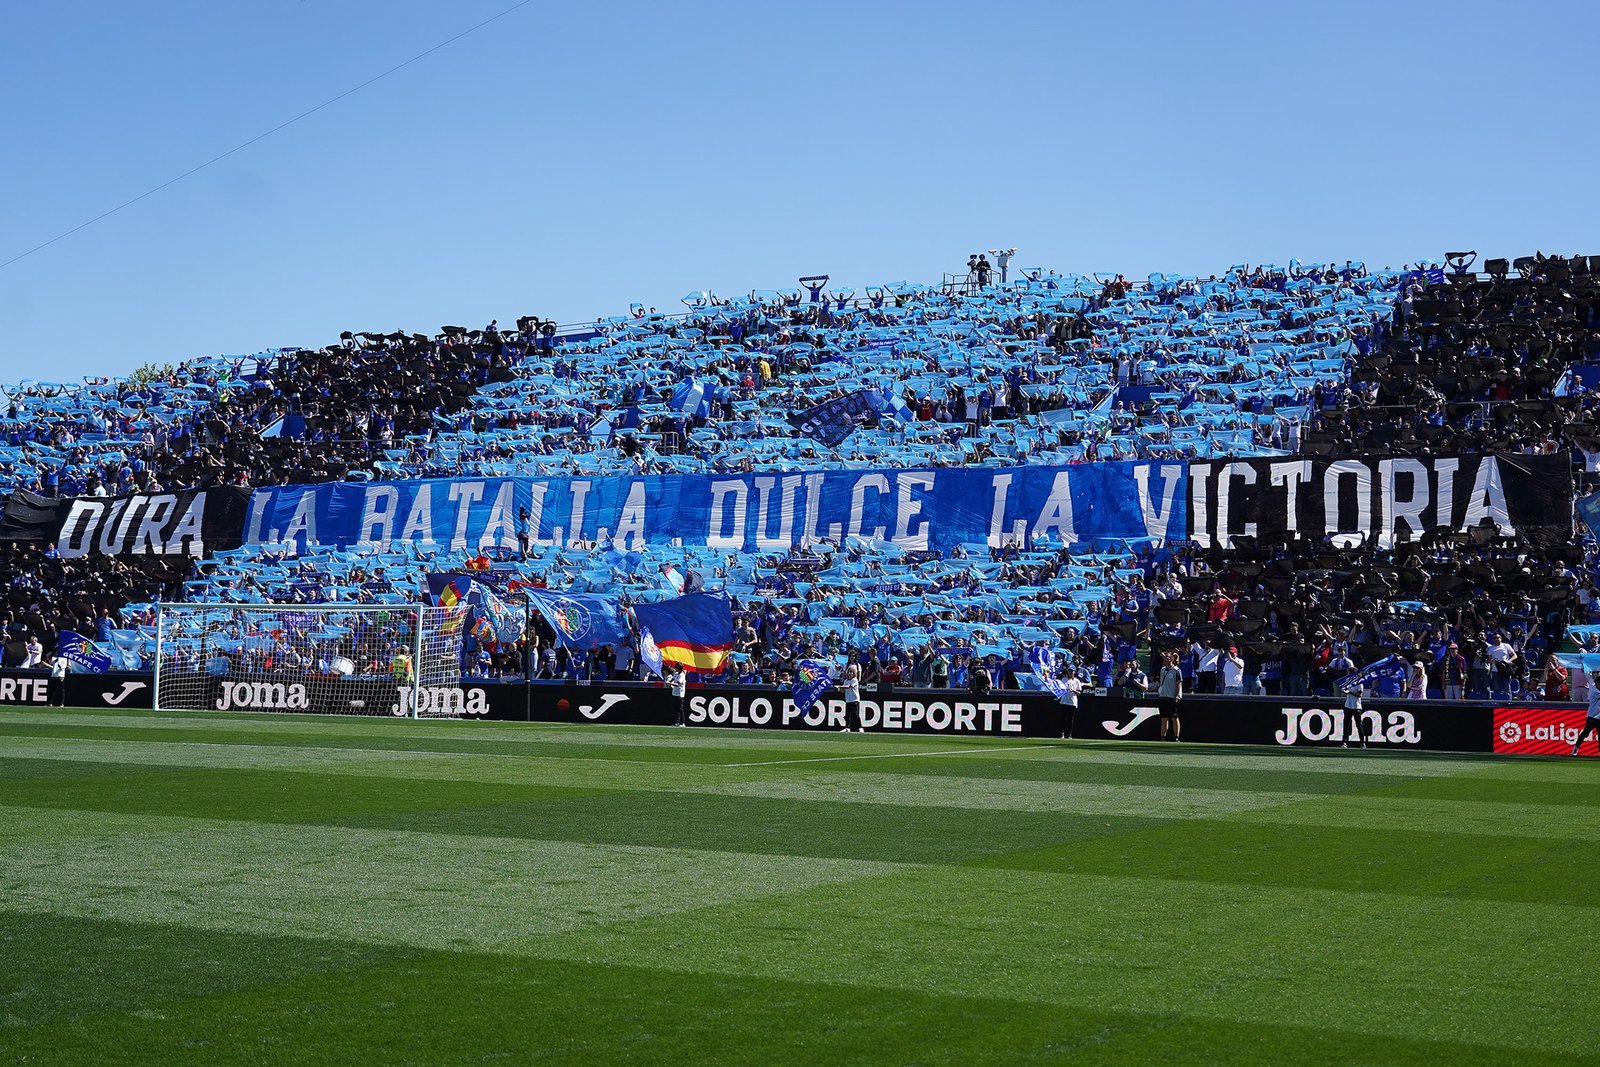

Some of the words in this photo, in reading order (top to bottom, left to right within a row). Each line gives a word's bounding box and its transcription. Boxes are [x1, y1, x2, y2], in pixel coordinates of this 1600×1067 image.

[57, 491, 207, 558] DURA
[247, 490, 320, 555] LA
[706, 471, 936, 551] DULCE
[987, 471, 1079, 550] LA
[1133, 455, 1516, 550] VICTORIA
[62, 651, 92, 669] GETAFE
[0, 678, 48, 702] RTE
[688, 696, 773, 725] SOLO
[781, 699, 847, 727] POR
[859, 700, 1023, 732] DEPORTE
